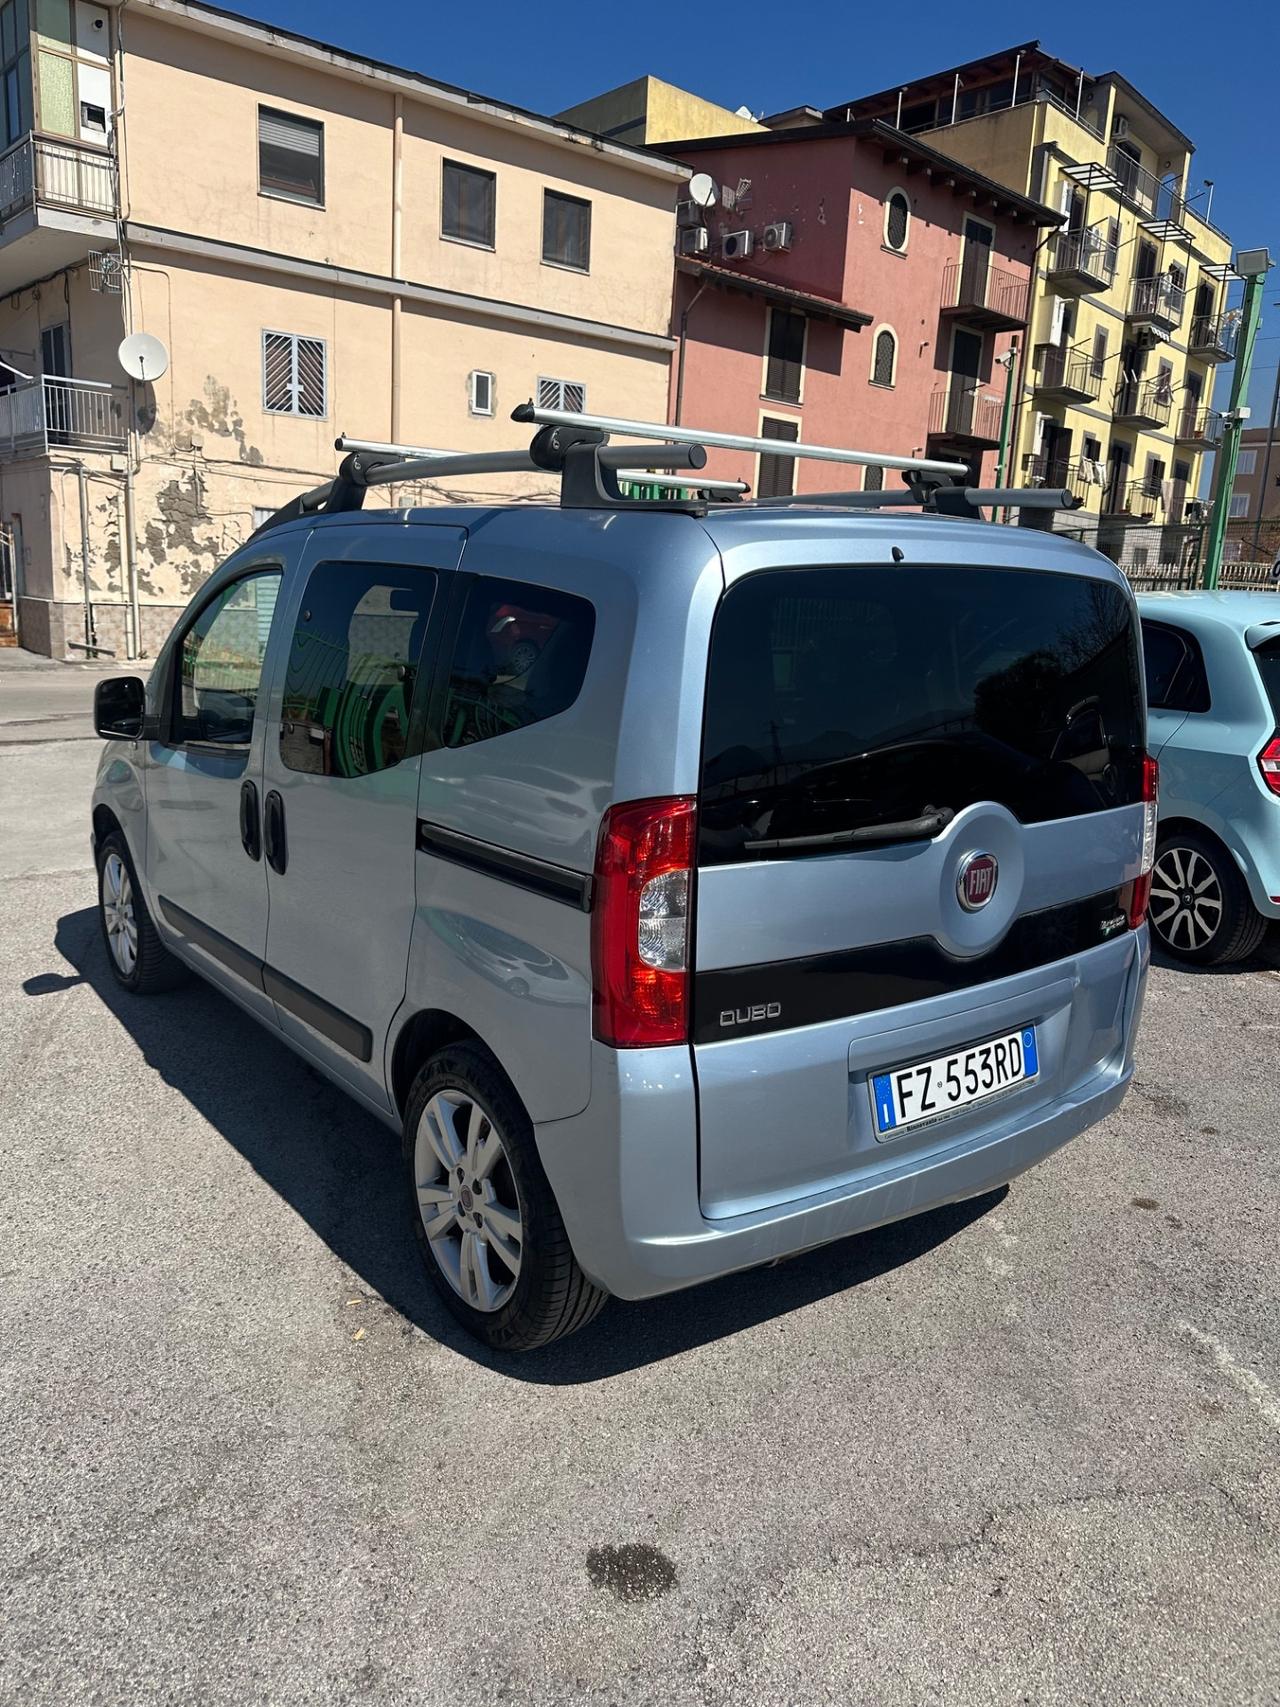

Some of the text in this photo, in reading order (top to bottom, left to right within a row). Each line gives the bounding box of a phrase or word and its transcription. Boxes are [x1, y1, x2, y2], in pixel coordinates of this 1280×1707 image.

[969, 867, 993, 895] FIAT
[720, 1002, 782, 1027] QUBO
[896, 1066, 936, 1118] FZ
[946, 1037, 1022, 1101] 553RD
